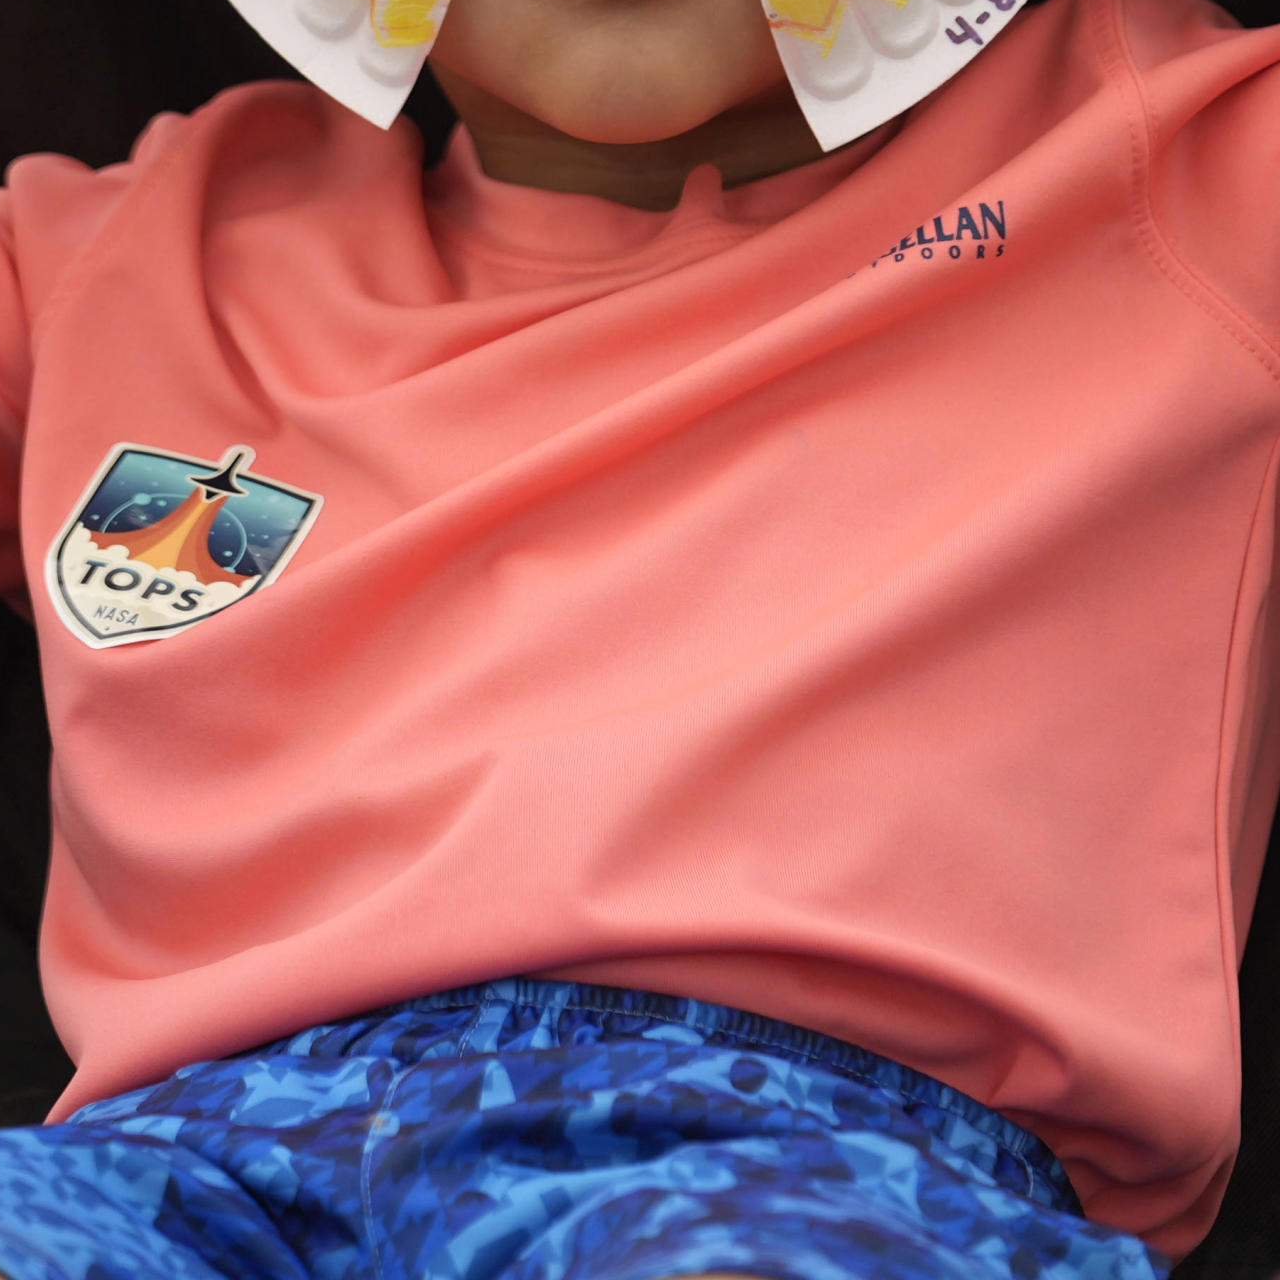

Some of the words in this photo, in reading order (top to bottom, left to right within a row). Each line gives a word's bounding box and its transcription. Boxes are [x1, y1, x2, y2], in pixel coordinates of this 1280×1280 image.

[879, 200, 1006, 259] ELLAN
[870, 244, 1005, 269] DOORS
[80, 560, 206, 611] TOPS
[92, 604, 139, 626] NASA
